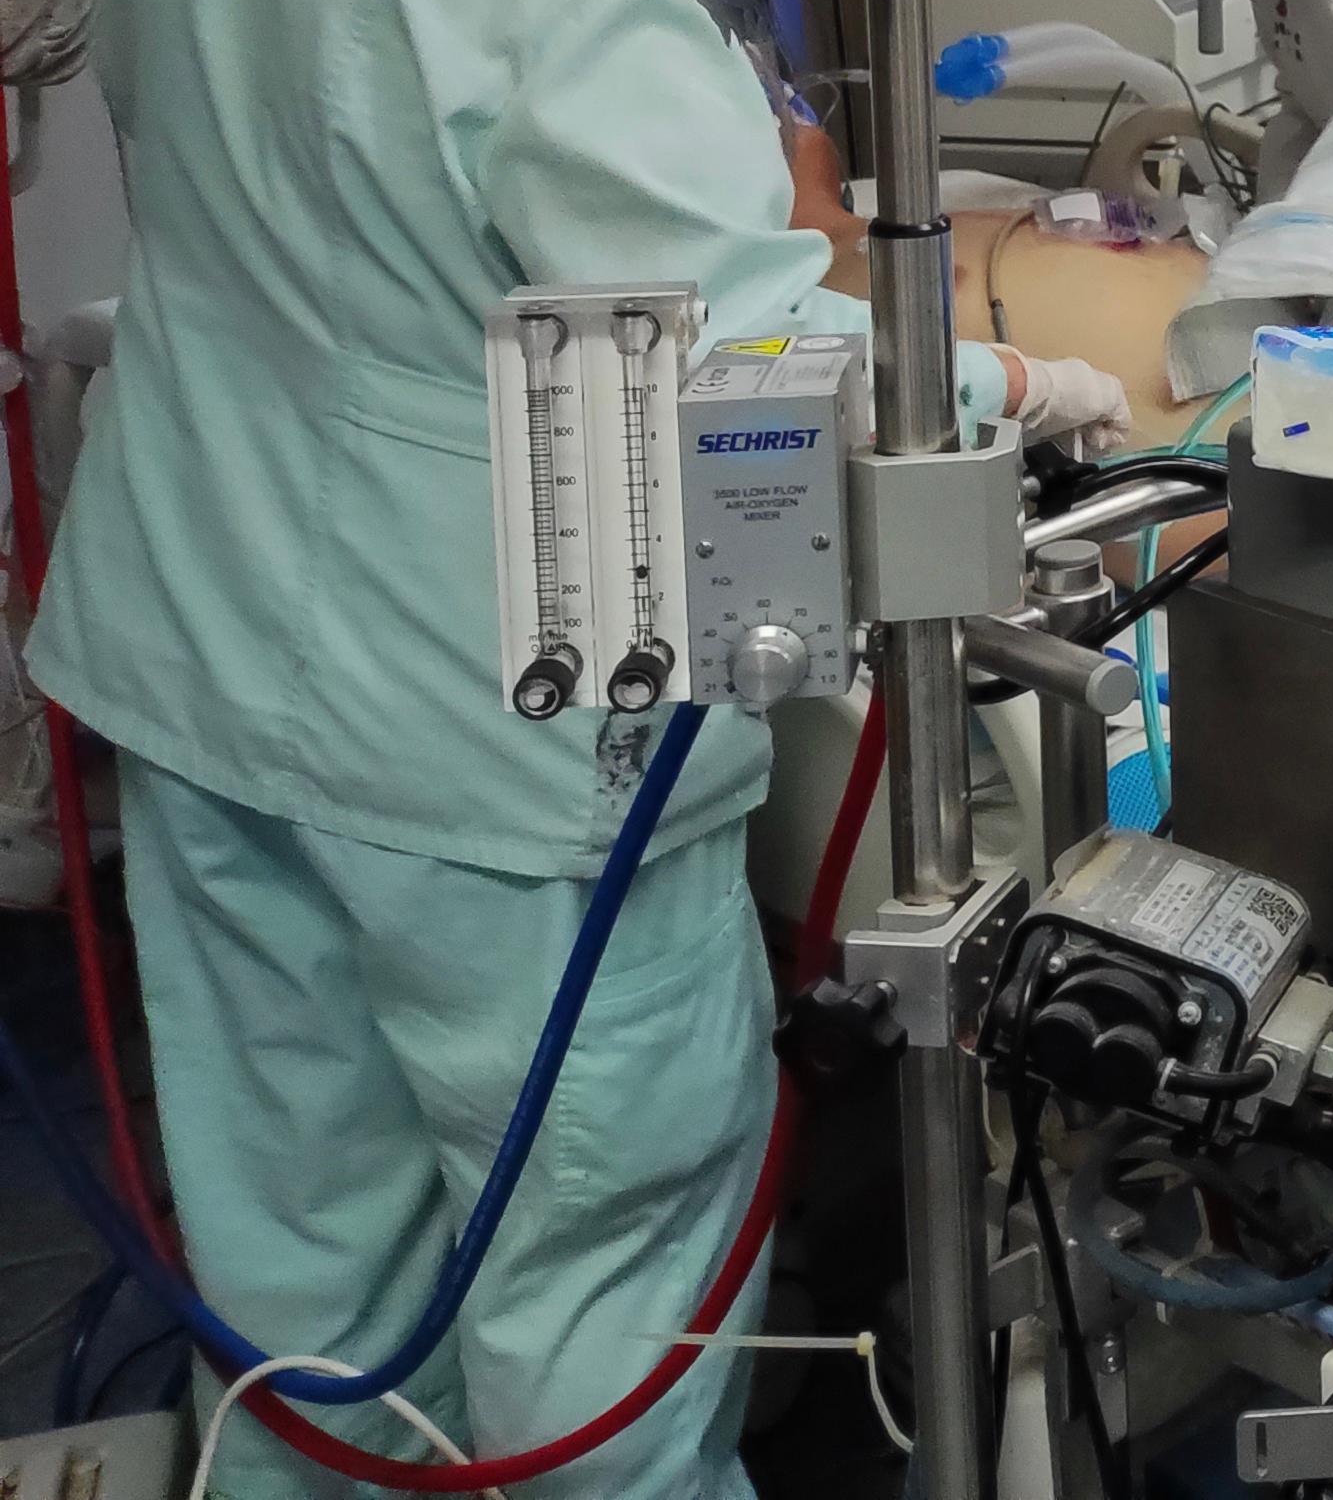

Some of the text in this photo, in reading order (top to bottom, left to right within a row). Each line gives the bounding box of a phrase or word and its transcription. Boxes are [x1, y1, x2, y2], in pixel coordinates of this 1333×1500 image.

[696, 428, 822, 454] SECHRIST
[774, 484, 808, 496] FLOW
[561, 584, 581, 596] 200
[564, 616, 583, 628] 100
